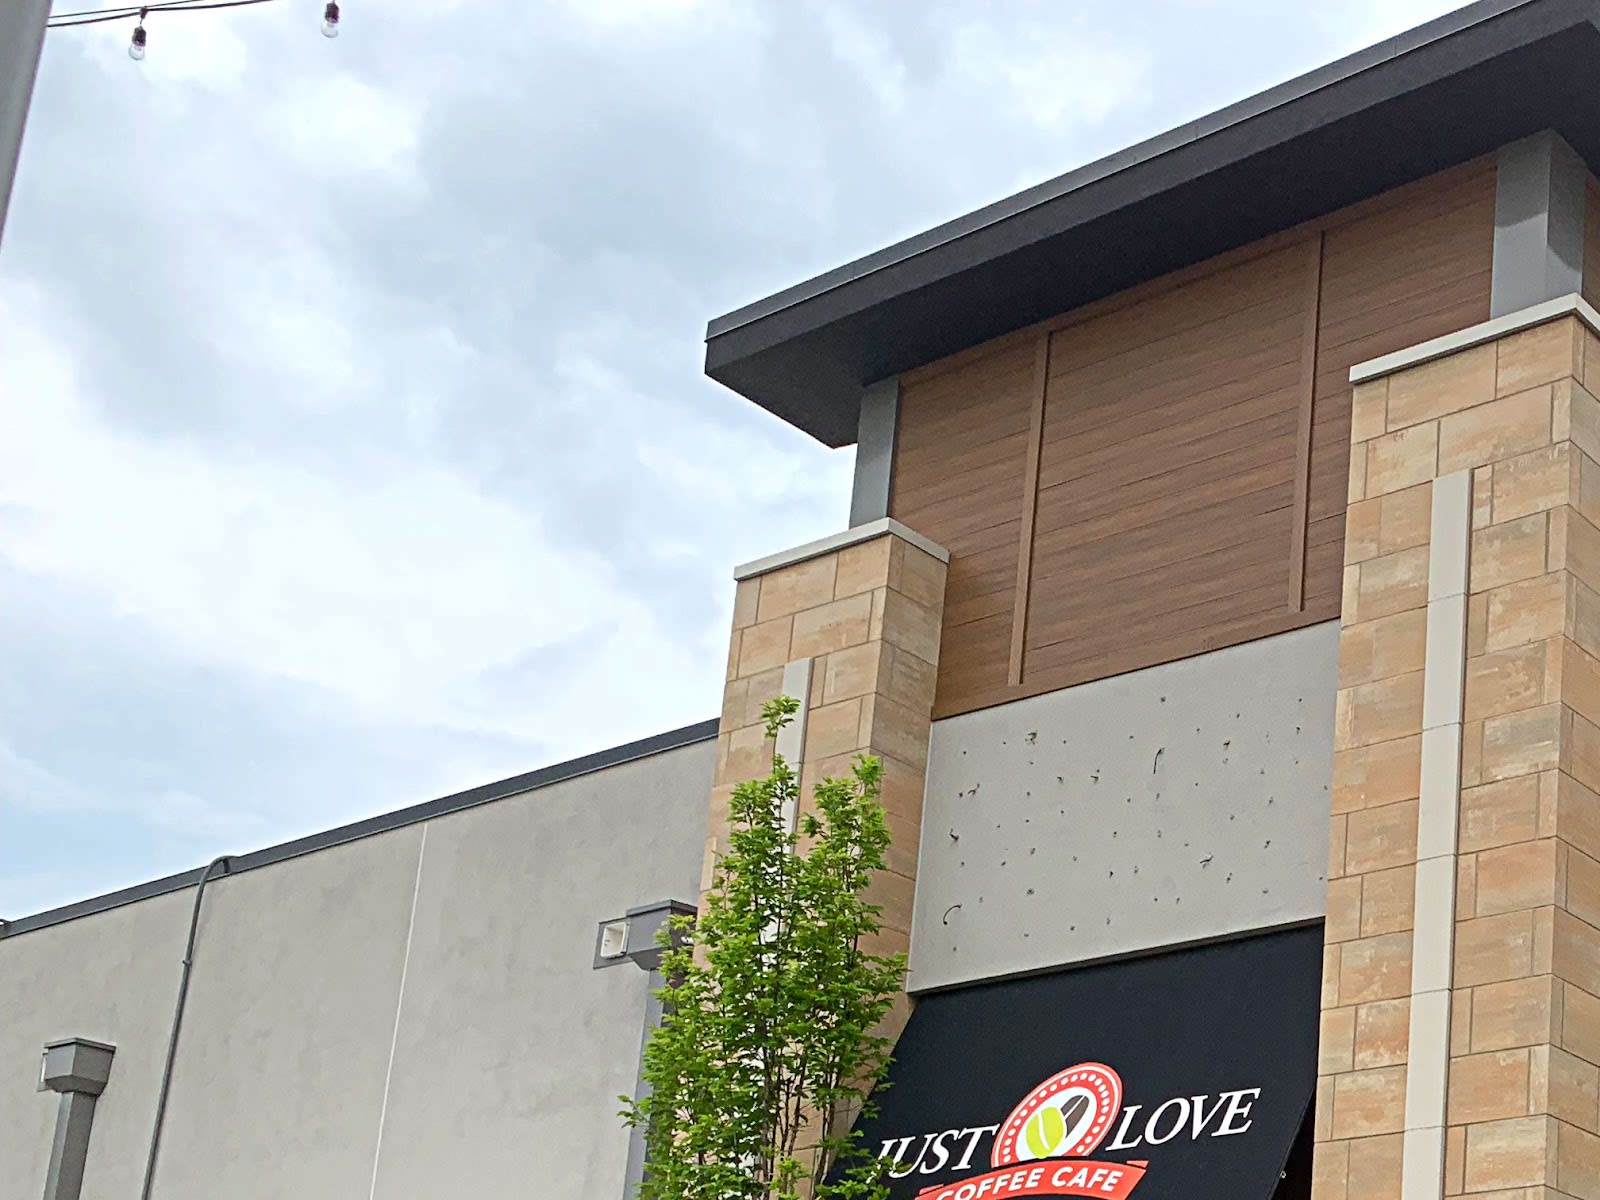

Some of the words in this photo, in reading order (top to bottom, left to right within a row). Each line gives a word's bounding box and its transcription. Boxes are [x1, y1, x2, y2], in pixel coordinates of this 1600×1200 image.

[866, 1123, 1000, 1184] JUST
[1105, 1087, 1262, 1151] LOVE
[1051, 1166, 1124, 1192] CAFE
